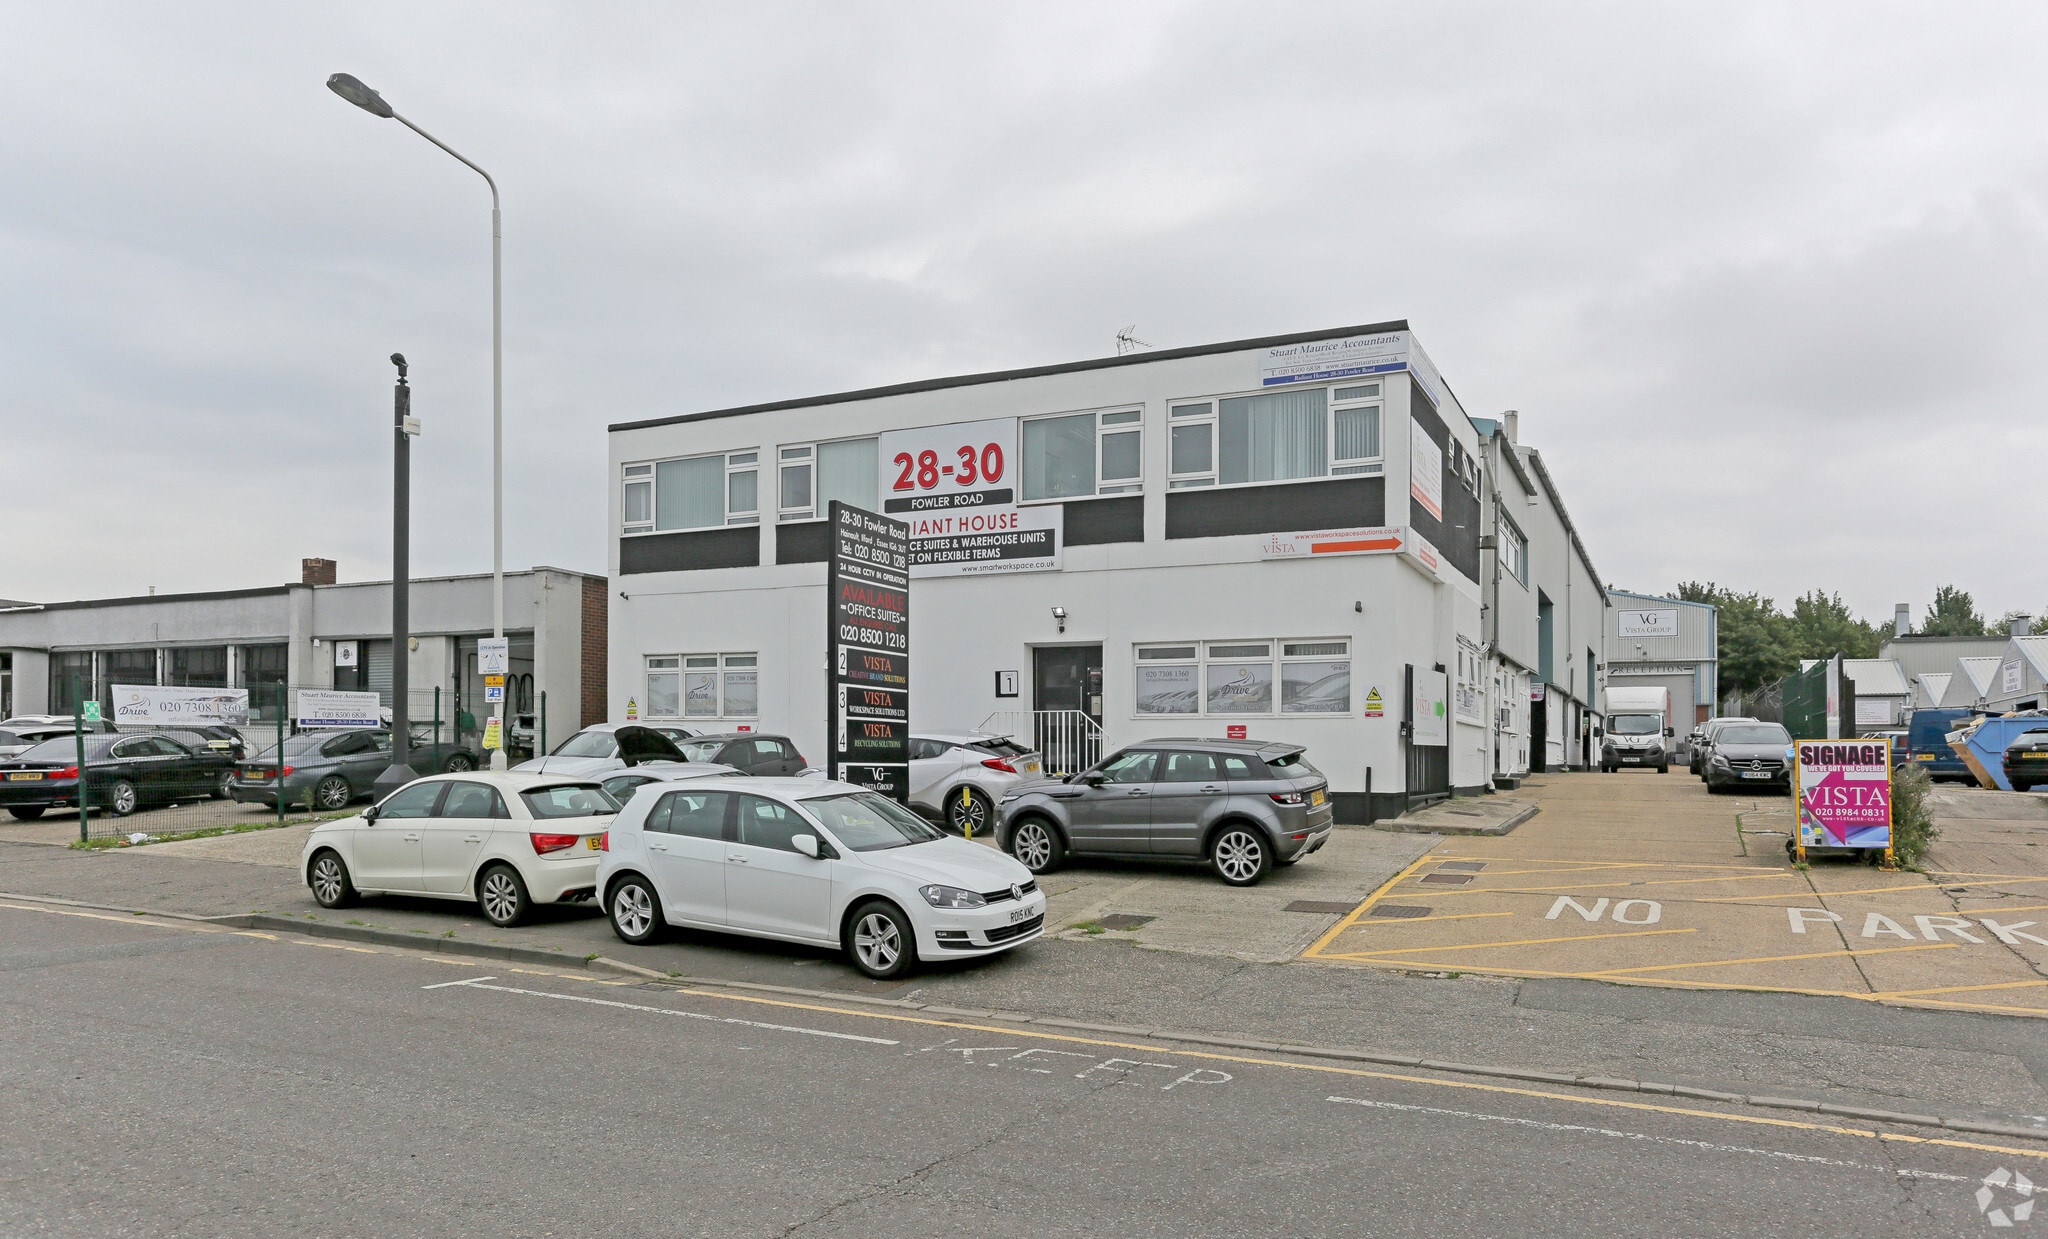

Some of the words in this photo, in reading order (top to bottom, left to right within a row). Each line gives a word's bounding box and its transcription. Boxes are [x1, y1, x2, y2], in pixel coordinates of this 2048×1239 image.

[1270, 348, 1298, 358] Stuart
[1300, 342, 1338, 354] Maurice
[1340, 334, 1400, 349] Accountants
[1278, 368, 1290, 376] 020
[892, 442, 1004, 492] 28-30
[911, 496, 950, 510] FOWLER
[954, 494, 984, 506] ROAD
[840, 510, 862, 528] 28-30
[864, 516, 888, 534] Fowler
[890, 524, 906, 540] Road
[909, 518, 952, 536] IANT
[959, 512, 1018, 532] HOUSE
[876, 538, 888, 549] Essex
[923, 538, 950, 550] SUITES
[952, 538, 958, 548] &
[961, 534, 1018, 548] WAREHOUSE
[1020, 532, 1046, 544] UNITS
[1263, 544, 1296, 554] VISTA
[1294, 528, 1401, 540] www.vistaworkspacesolutions.co.uk
[841, 540, 852, 554] Tel:
[854, 544, 868, 559] 020
[872, 548, 890, 564] 8500
[892, 554, 906, 568] 1218
[917, 552, 932, 563] ON
[934, 550, 970, 562] FLEXIBLE
[972, 548, 1001, 560] TERMS
[840, 562, 846, 570] 24
[848, 564, 862, 574] HOUR
[862, 568, 876, 577] CCTV
[882, 574, 906, 585] OPERATION
[962, 560, 1055, 573] www.smartworkspace.co.uk
[842, 584, 905, 612] AVAILABLE
[847, 602, 876, 619] OFFICE
[878, 608, 900, 624] SUITES
[840, 624, 858, 642] 020
[860, 628, 882, 645] 8500
[885, 632, 906, 648] 1218
[1625, 626, 1646, 634] VISTA
[840, 652, 846, 670] 2
[864, 656, 892, 672] VISTA
[1618, 666, 1683, 674] RECEPTION
[870, 672, 884, 680] BRAND
[884, 674, 906, 684] SOLUTIONS
[1007, 678, 1012, 692] 1
[688, 690, 709, 700] Drive
[1220, 684, 1250, 695] Drive
[840, 692, 846, 708] 3
[864, 691, 892, 706] VISTA
[118, 706, 149, 716] Drive
[160, 702, 180, 712] 020
[184, 702, 212, 712] 7308
[216, 703, 241, 712] 1360
[848, 705, 874, 714] WORKSPACE
[875, 708, 897, 716] SOLUTIONS
[864, 724, 892, 738] VISTA
[840, 732, 846, 748] 4
[854, 740, 878, 748] RECYCLING
[879, 740, 901, 748] SOLUTIONS
[1800, 745, 1886, 766] SIGNAGE
[876, 782, 894, 790] GROUP
[1802, 786, 1887, 806] VISTA
[1815, 808, 1833, 816] 020
[1835, 808, 1859, 816] 8984
[1862, 808, 1884, 817] 0831
[1010, 910, 1023, 923] RO15
[1544, 895, 1662, 925] NO
[1786, 907, 2048, 947] PARK
